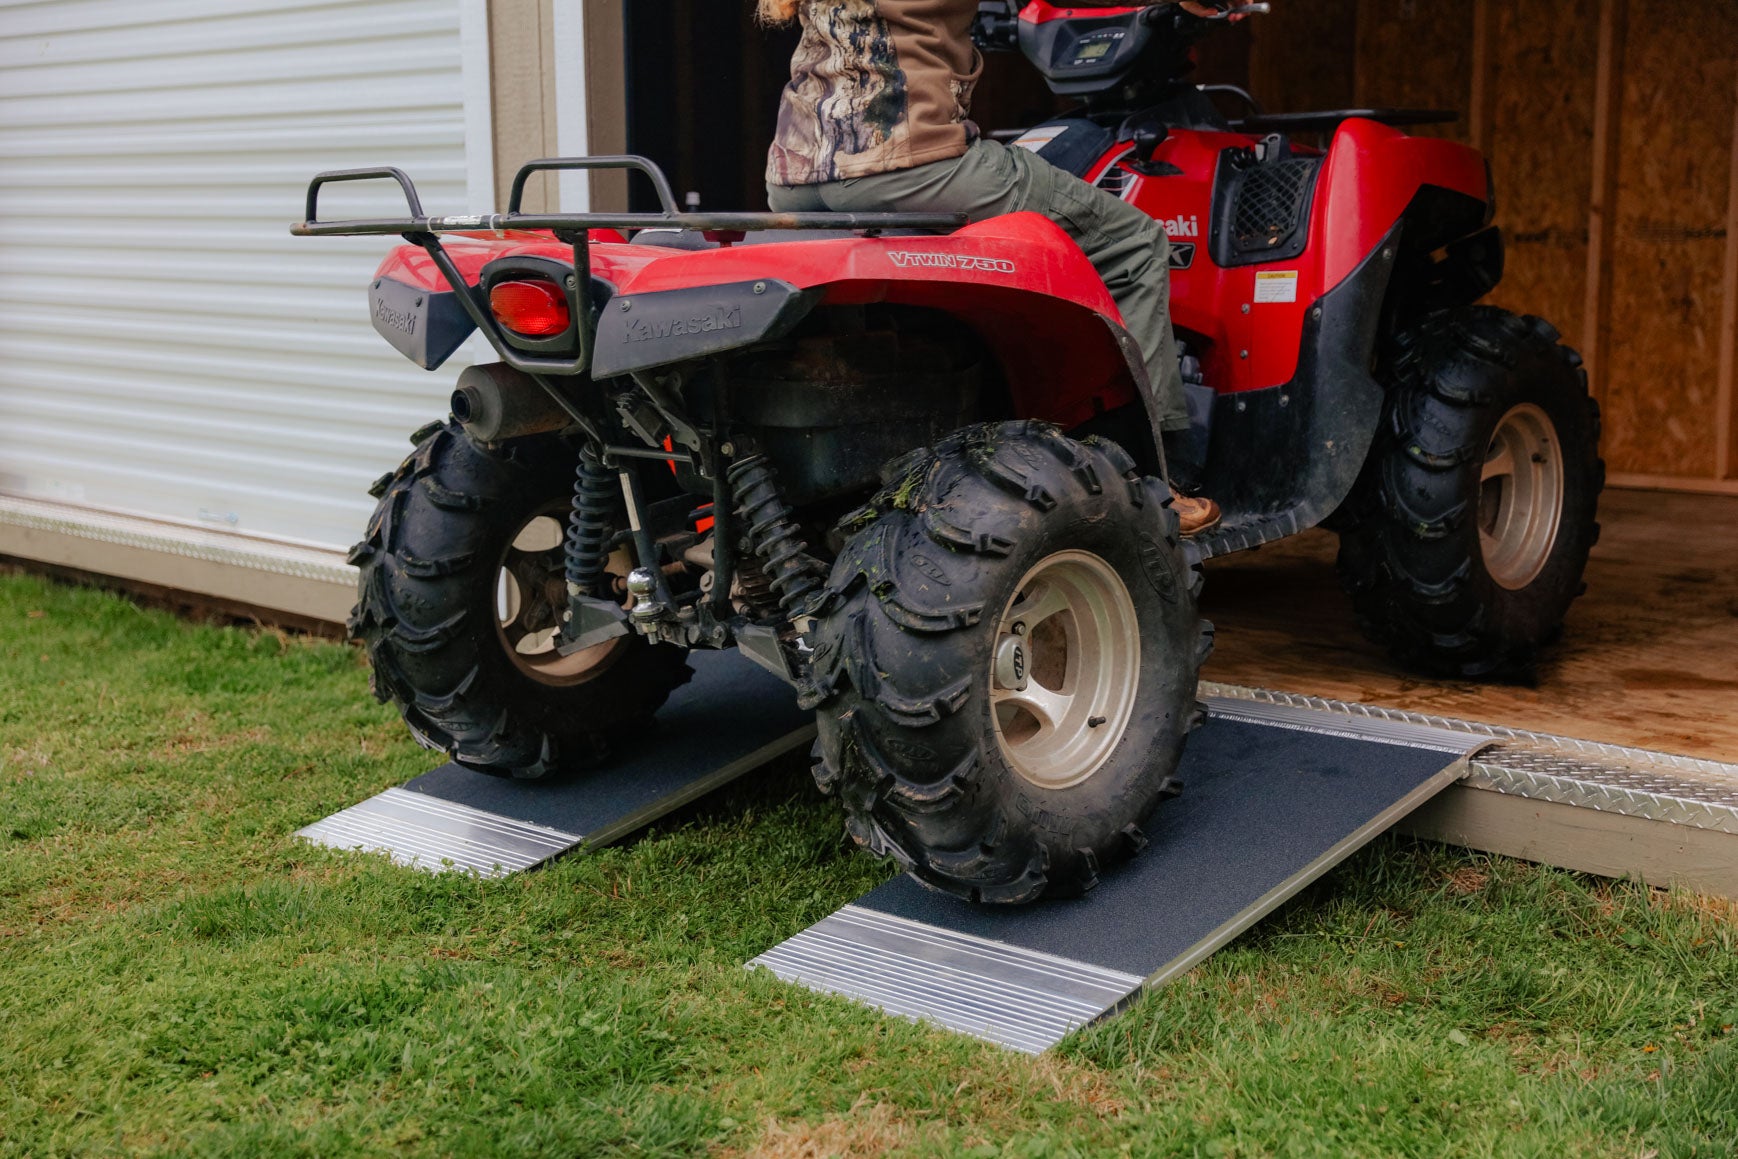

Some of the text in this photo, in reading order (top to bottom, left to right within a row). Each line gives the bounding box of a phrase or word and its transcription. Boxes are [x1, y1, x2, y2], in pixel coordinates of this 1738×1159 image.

[957, 255, 1015, 274] 750
[376, 297, 417, 335] Kawasaki
[622, 304, 742, 344] Kawasaki
[1014, 648, 1023, 679] ITP
